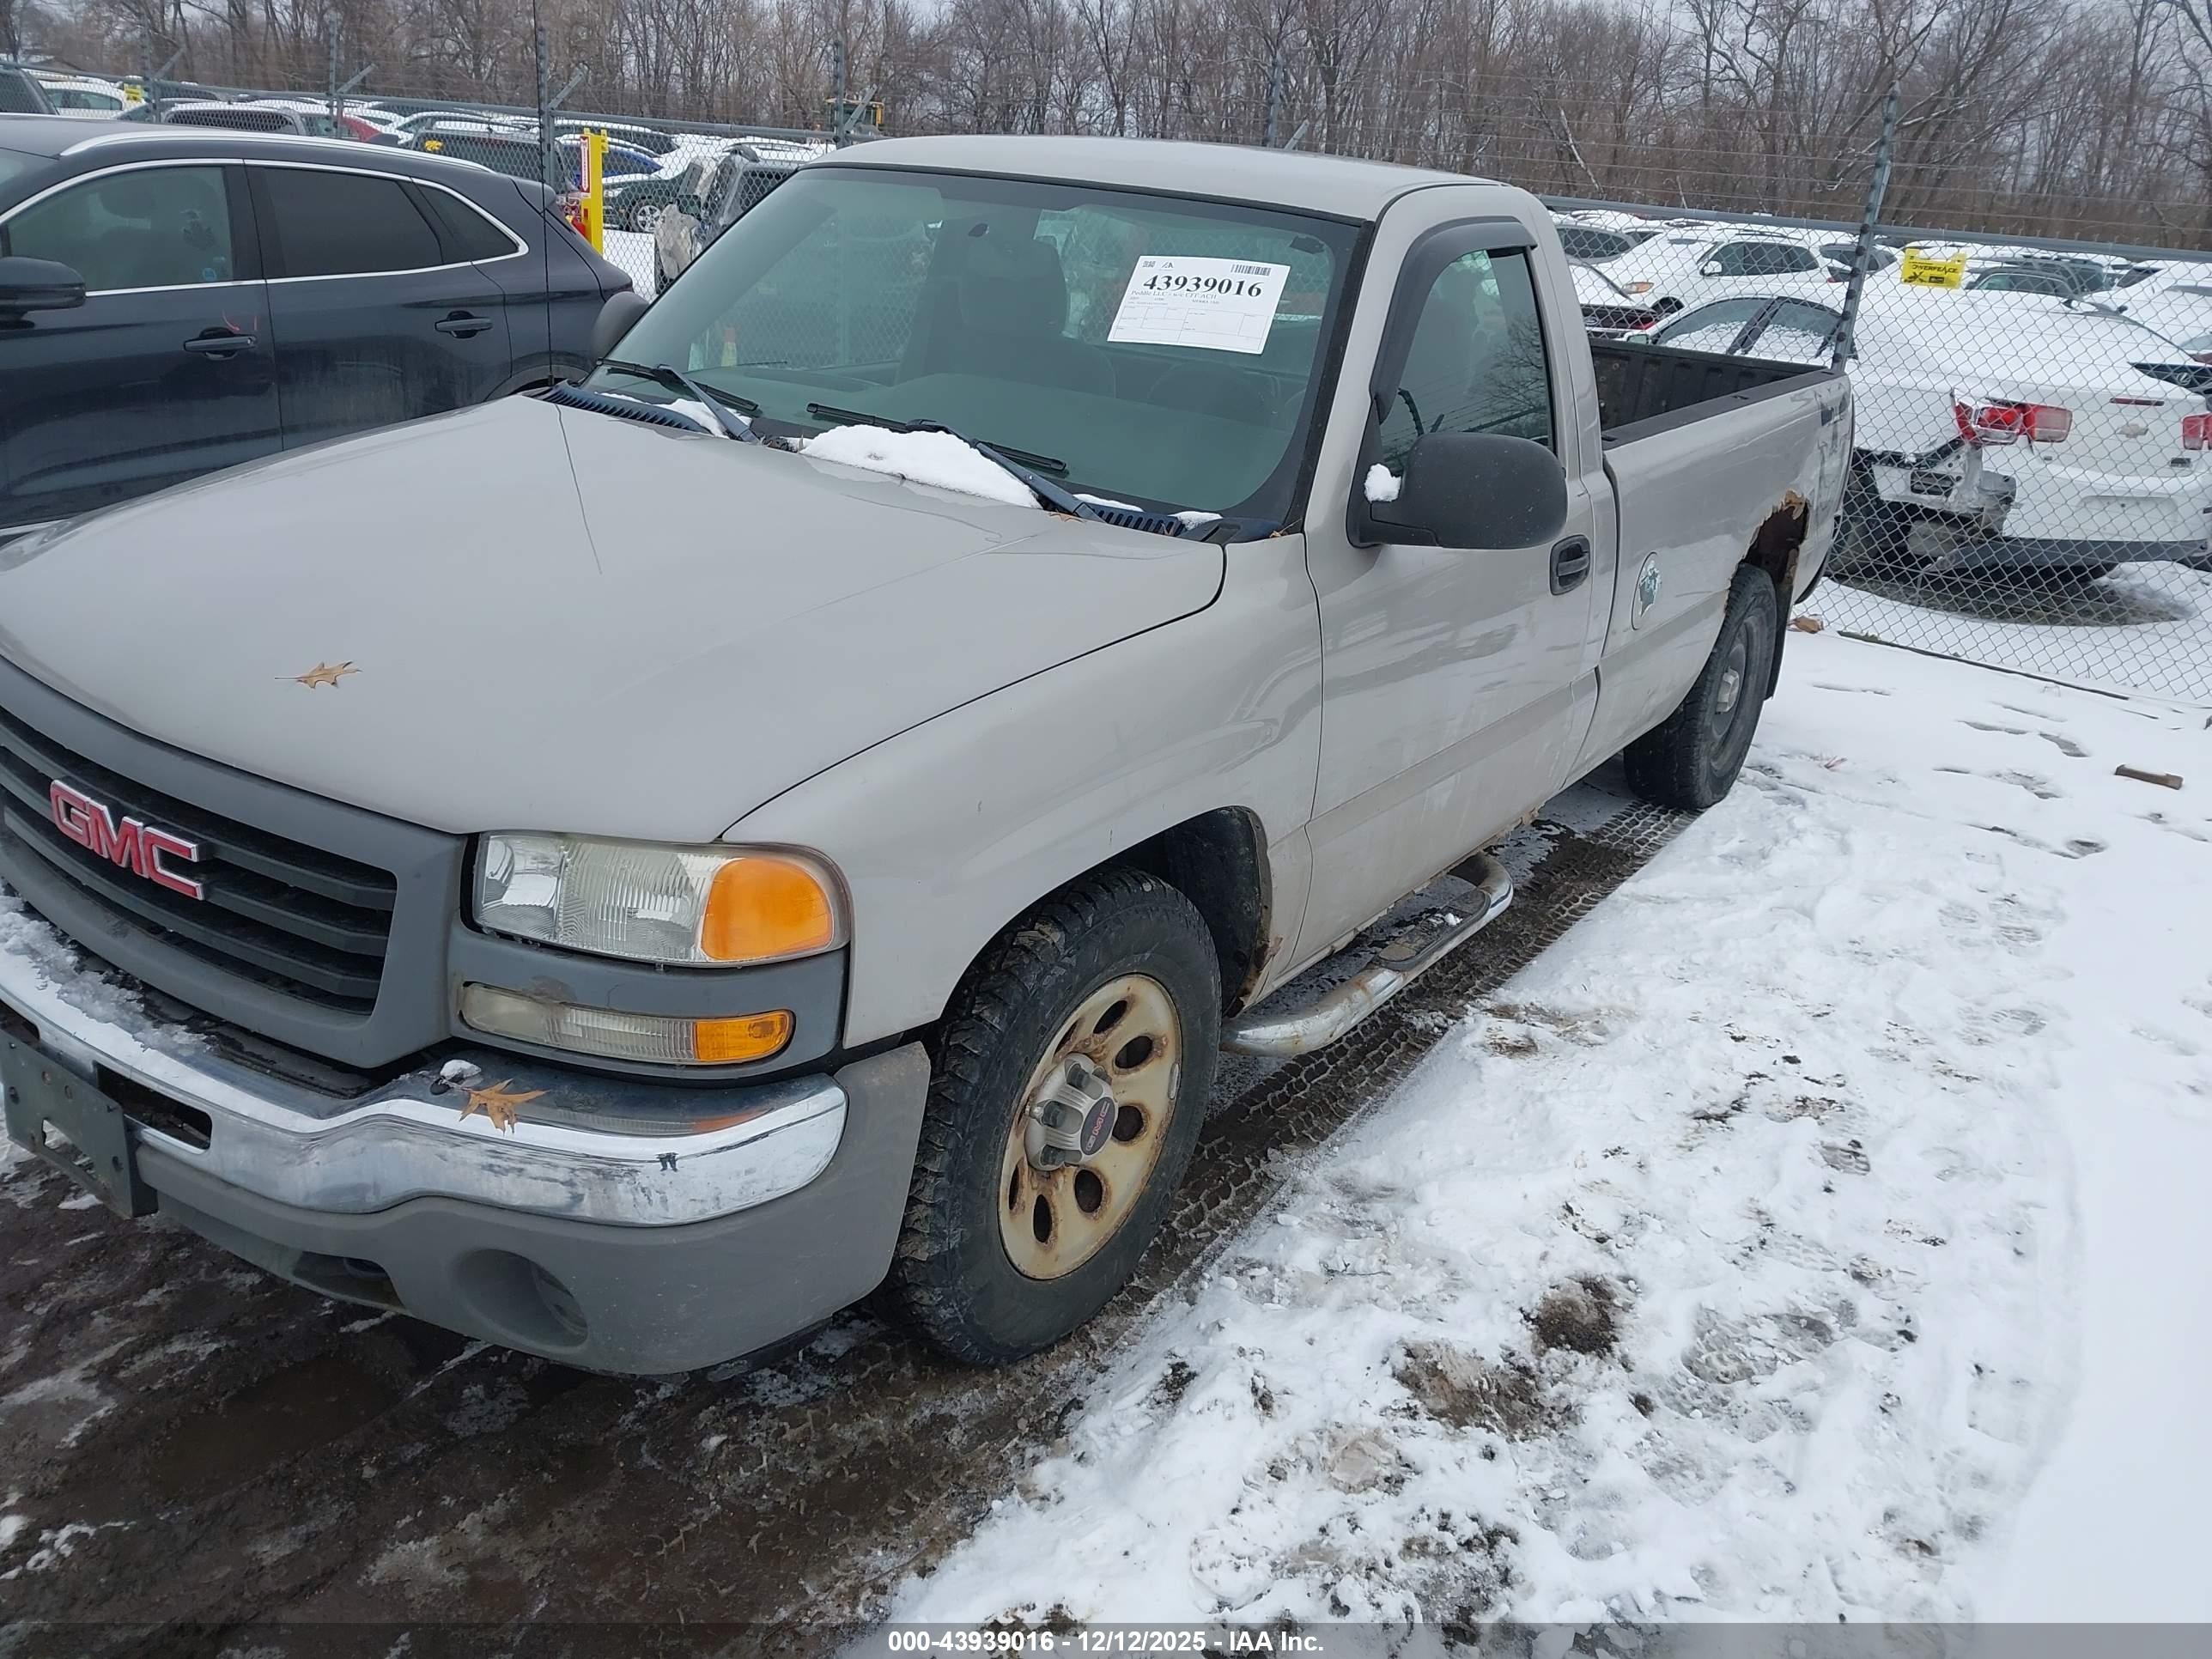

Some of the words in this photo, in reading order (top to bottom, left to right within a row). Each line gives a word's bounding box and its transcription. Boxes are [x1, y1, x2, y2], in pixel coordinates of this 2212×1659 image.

[1143, 274, 1264, 297] 43939016
[50, 779, 205, 901] GMC
[1086, 1101, 1110, 1152] GMC
